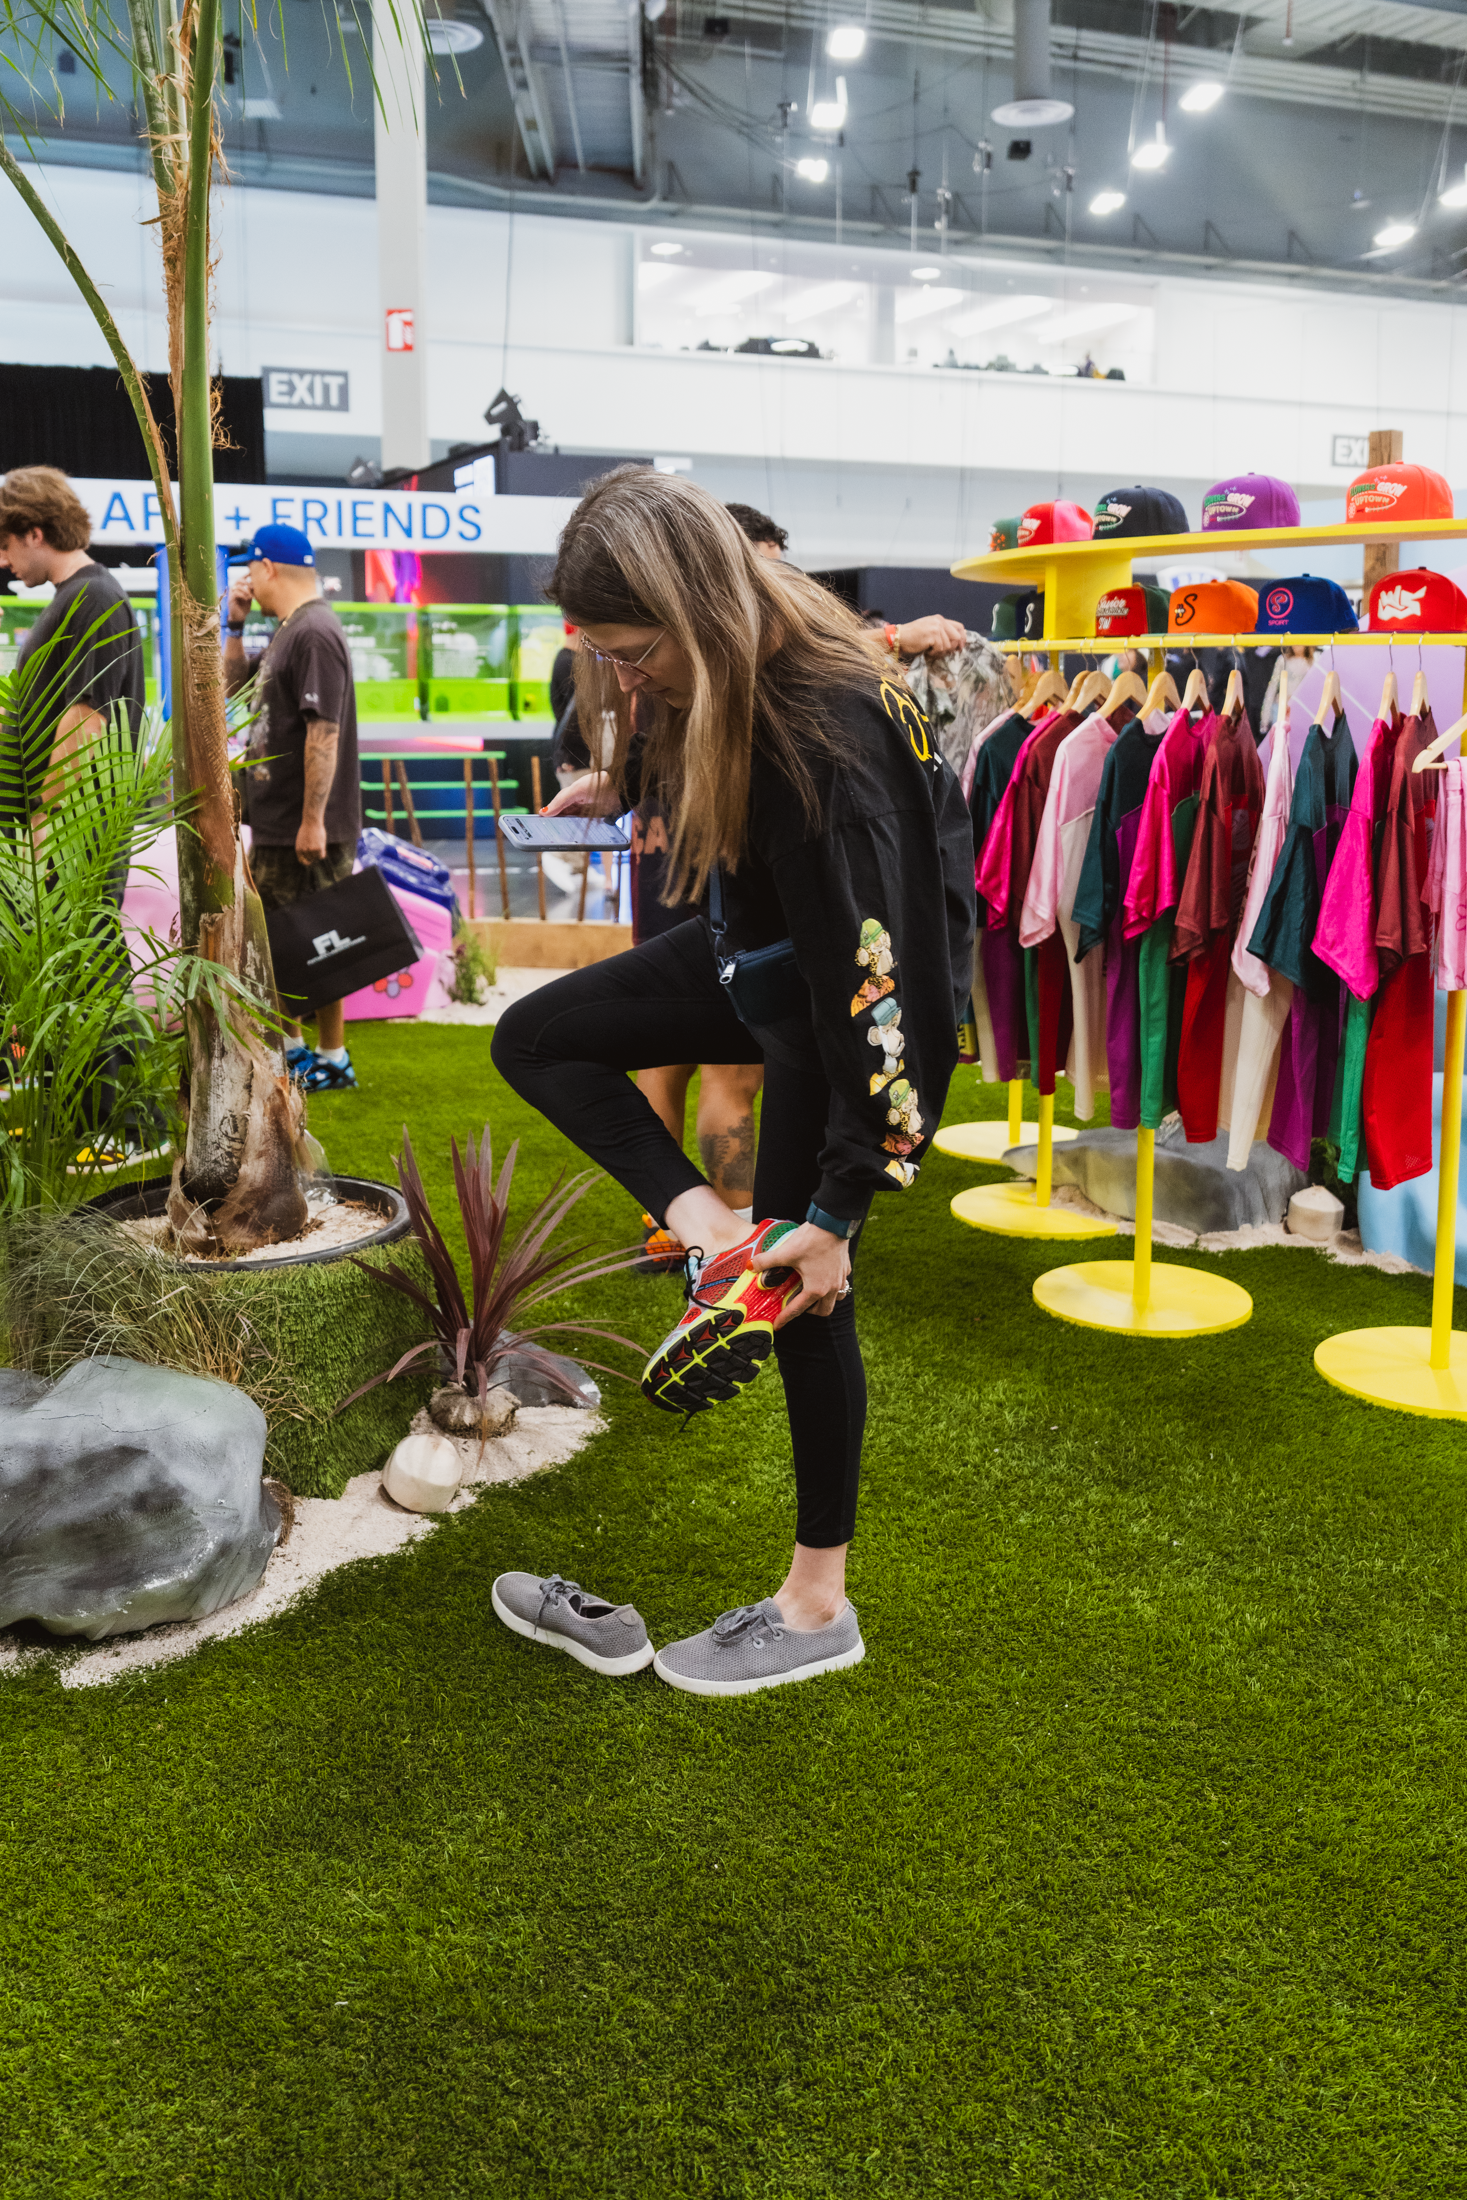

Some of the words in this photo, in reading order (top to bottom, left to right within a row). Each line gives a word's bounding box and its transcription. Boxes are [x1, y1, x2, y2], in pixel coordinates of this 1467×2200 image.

[268, 371, 346, 407] EXIT
[1335, 437, 1369, 465] EXI
[1226, 492, 1256, 508] GROW
[1354, 494, 1390, 507] UPTOWN
[1376, 481, 1408, 498] GROW
[271, 497, 482, 542] FRIENDS
[1207, 504, 1240, 516] UPTOWN
[1175, 593, 1198, 627] S
[1267, 619, 1290, 627] SPORT
[311, 928, 351, 957] FL
